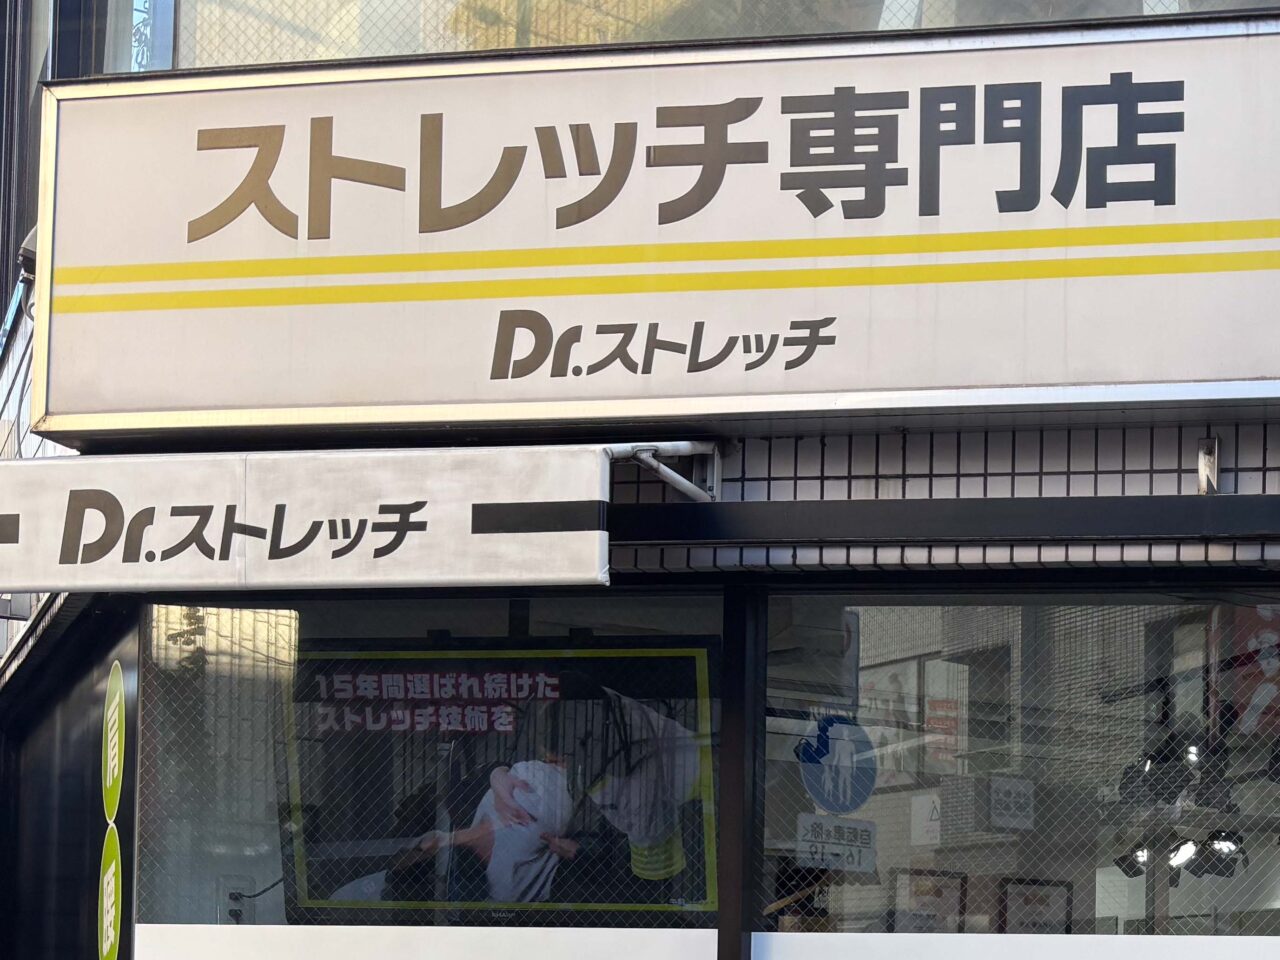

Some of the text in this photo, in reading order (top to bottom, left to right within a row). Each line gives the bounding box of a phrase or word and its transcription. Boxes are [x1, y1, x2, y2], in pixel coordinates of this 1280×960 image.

[187, 72, 1185, 243] ストレッチ専門店
[490, 309, 837, 380] Dr.ストレッチ
[58, 489, 428, 564] Dr.ストレッチ
